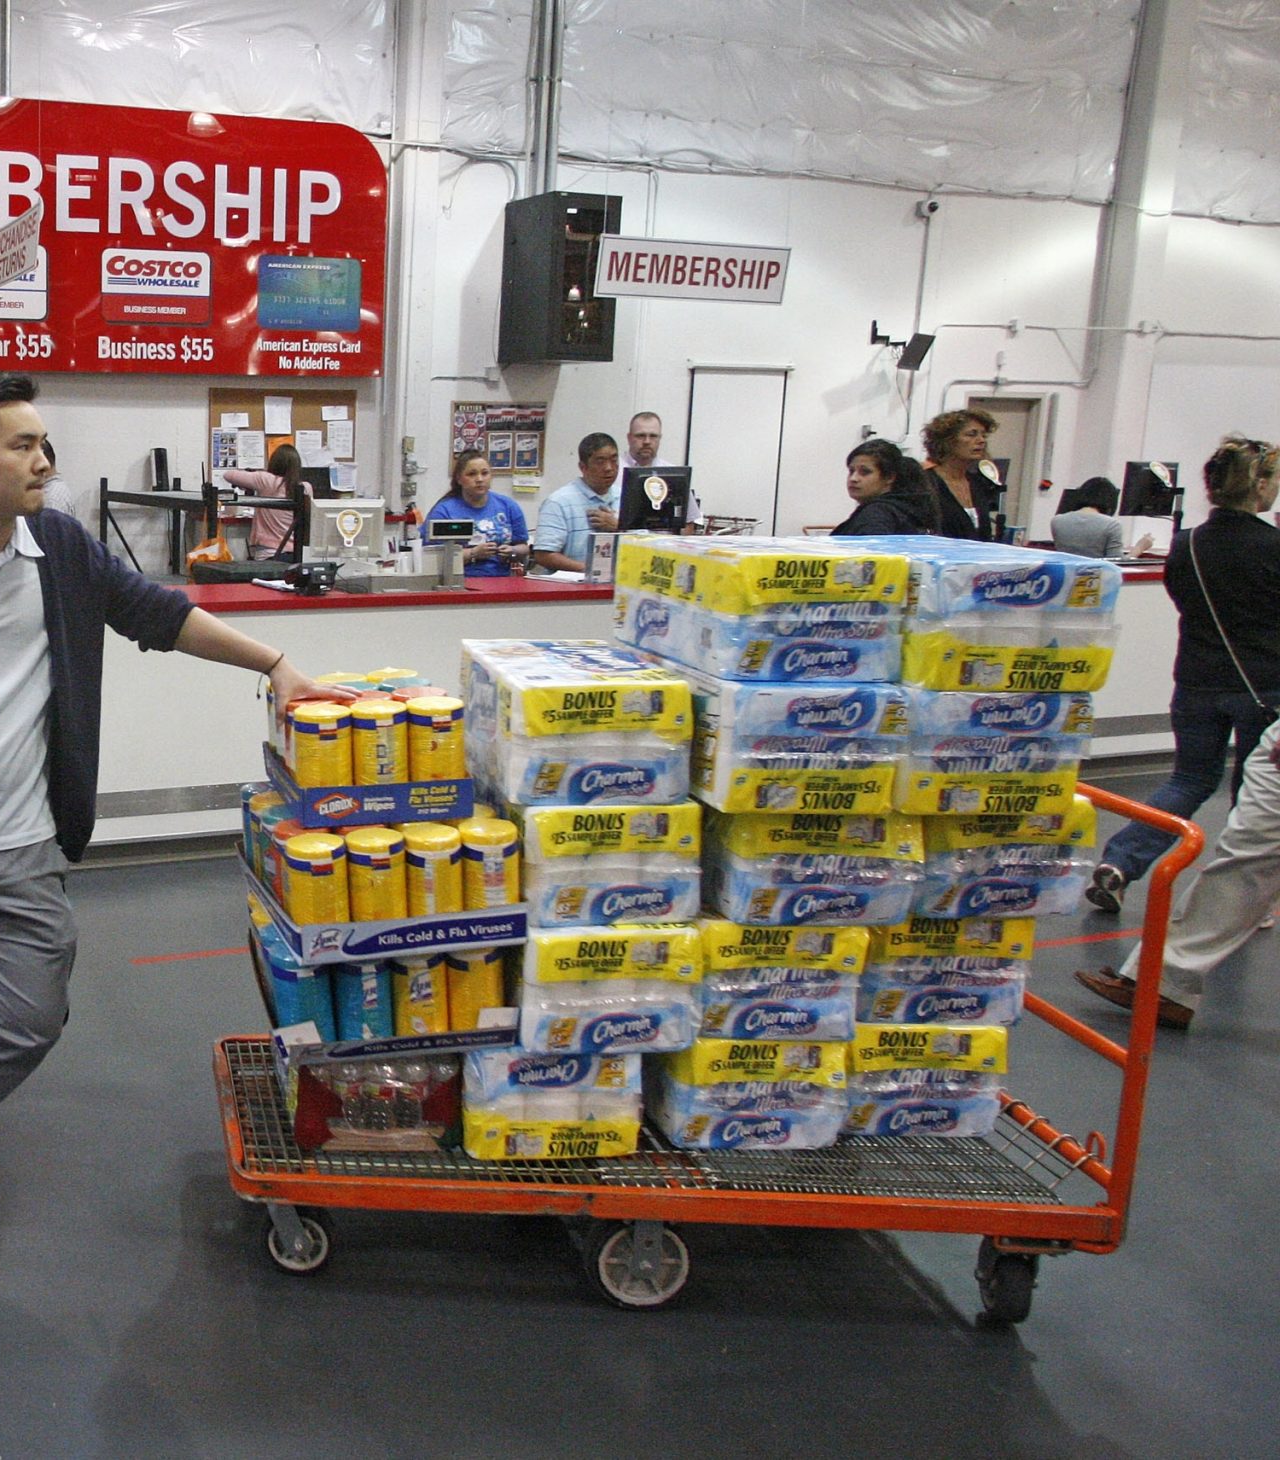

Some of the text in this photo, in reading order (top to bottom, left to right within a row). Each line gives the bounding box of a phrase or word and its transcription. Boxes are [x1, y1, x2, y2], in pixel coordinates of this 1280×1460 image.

[106, 255, 202, 278] COSTCO
[607, 251, 781, 290] MEMBERSHIP
[136, 278, 200, 288] WHOLESALE
[124, 305, 186, 315] BUSINESS MEMBER
[15, 331, 52, 361] $55
[98, 335, 213, 363] Business $55
[257, 338, 361, 355] American Express Card
[279, 356, 340, 370] No Added Fee
[775, 560, 830, 578] BONUS
[984, 574, 1051, 600] Charmin
[785, 647, 849, 672] Charmin
[1006, 670, 1064, 689] BONUS
[563, 690, 617, 710] BONUS
[797, 703, 863, 727] Charmin
[981, 701, 1046, 727] Charmin
[581, 768, 645, 793] Charmin
[319, 797, 396, 815] CLOROX Wipes
[800, 792, 856, 810] BONUS
[982, 795, 1038, 812] BONUS
[572, 813, 626, 832] BONUS
[792, 814, 843, 831] BONUS
[602, 891, 664, 916] Charmin
[793, 892, 857, 917] Charmin
[909, 917, 961, 934] BONUS
[378, 934, 403, 945] Kills
[406, 931, 433, 943] Cold
[435, 929, 446, 940] &
[449, 927, 467, 938] Flu
[740, 929, 793, 946] BONUS
[577, 940, 629, 958] BONUS
[916, 996, 977, 1017] Charmin
[745, 1008, 809, 1031] Charmin
[593, 1017, 651, 1043] Charmin
[878, 1031, 929, 1047] BONUS
[728, 1043, 780, 1060] BONUS
[519, 1059, 578, 1085] Charmin
[889, 1107, 949, 1129] Charmin
[722, 1116, 782, 1141] Charmin
[547, 1141, 598, 1158] BONUS
